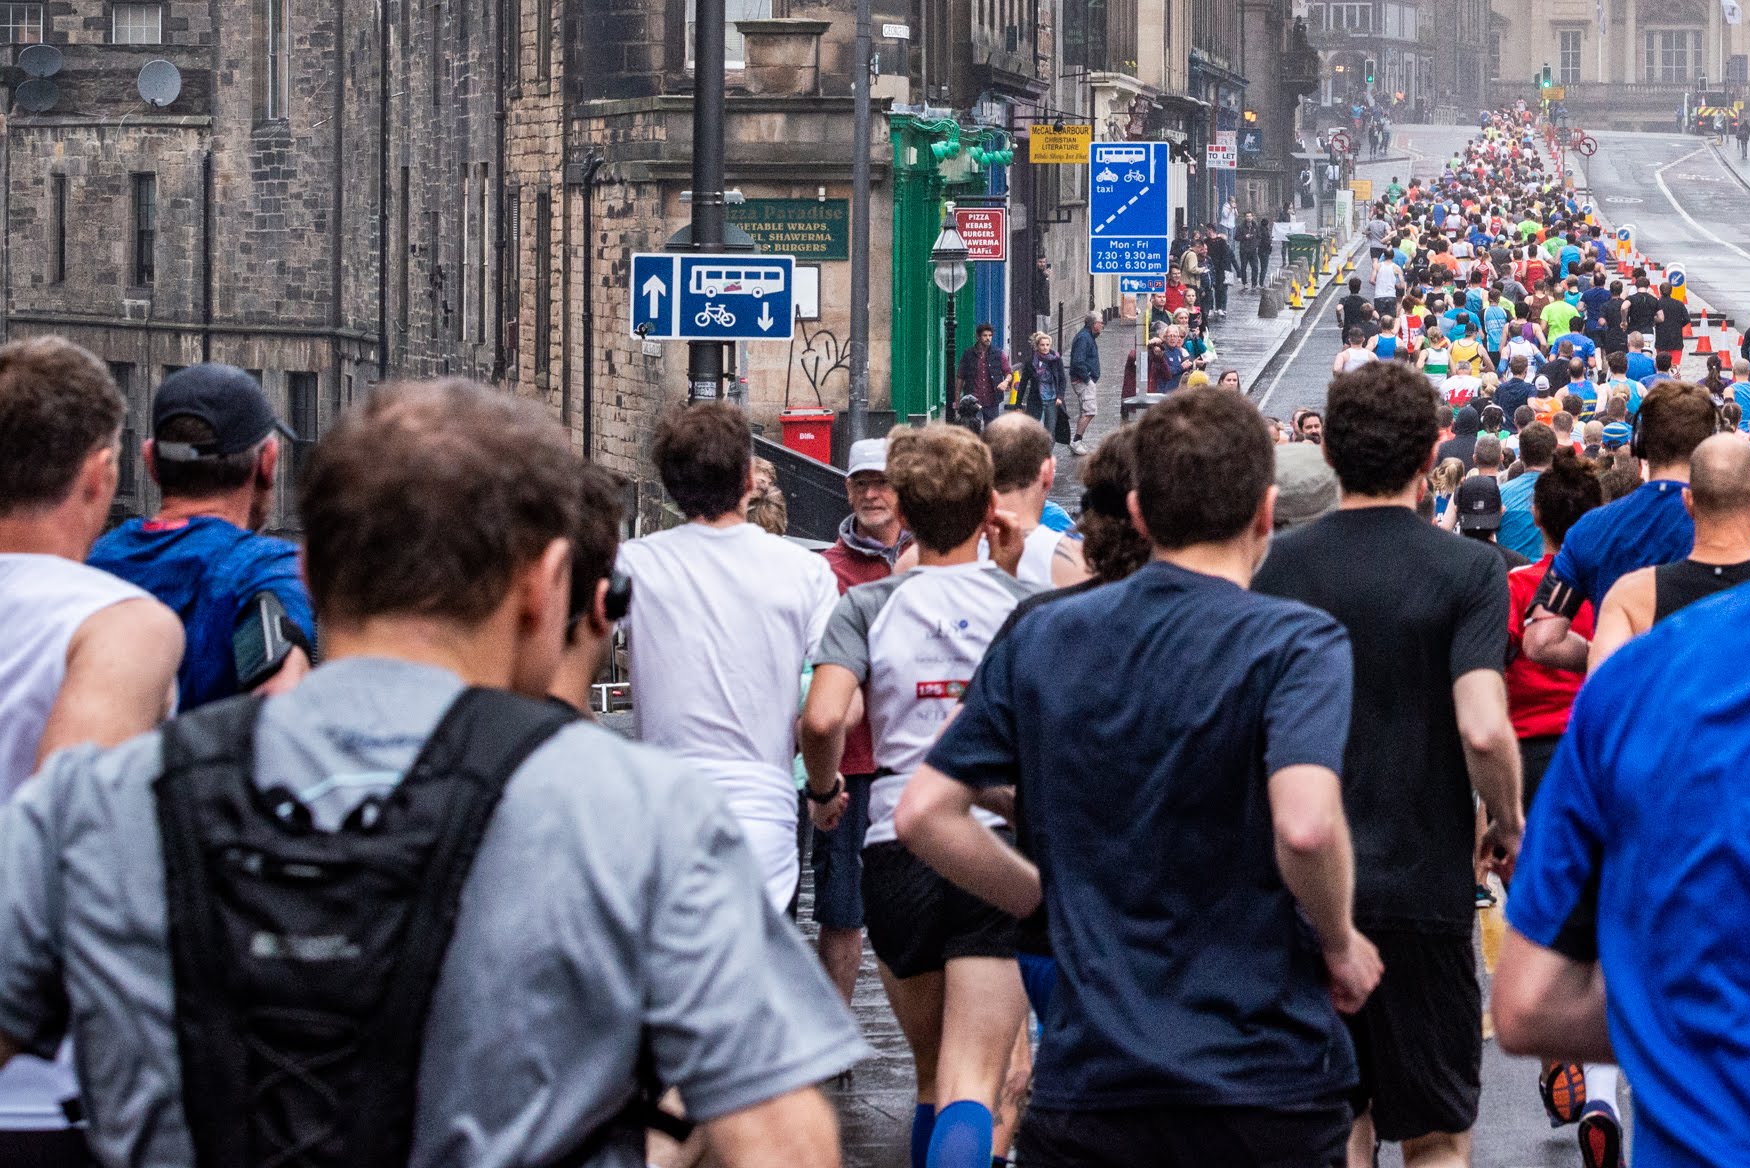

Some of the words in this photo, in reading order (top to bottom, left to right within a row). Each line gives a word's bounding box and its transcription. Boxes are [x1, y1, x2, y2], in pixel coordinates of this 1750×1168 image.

[725, 206, 758, 219] izza
[764, 206, 843, 220] Paradise
[774, 244, 827, 252] BURGERS
[1110, 241, 1130, 249] Mon
[1137, 241, 1149, 249] Fri
